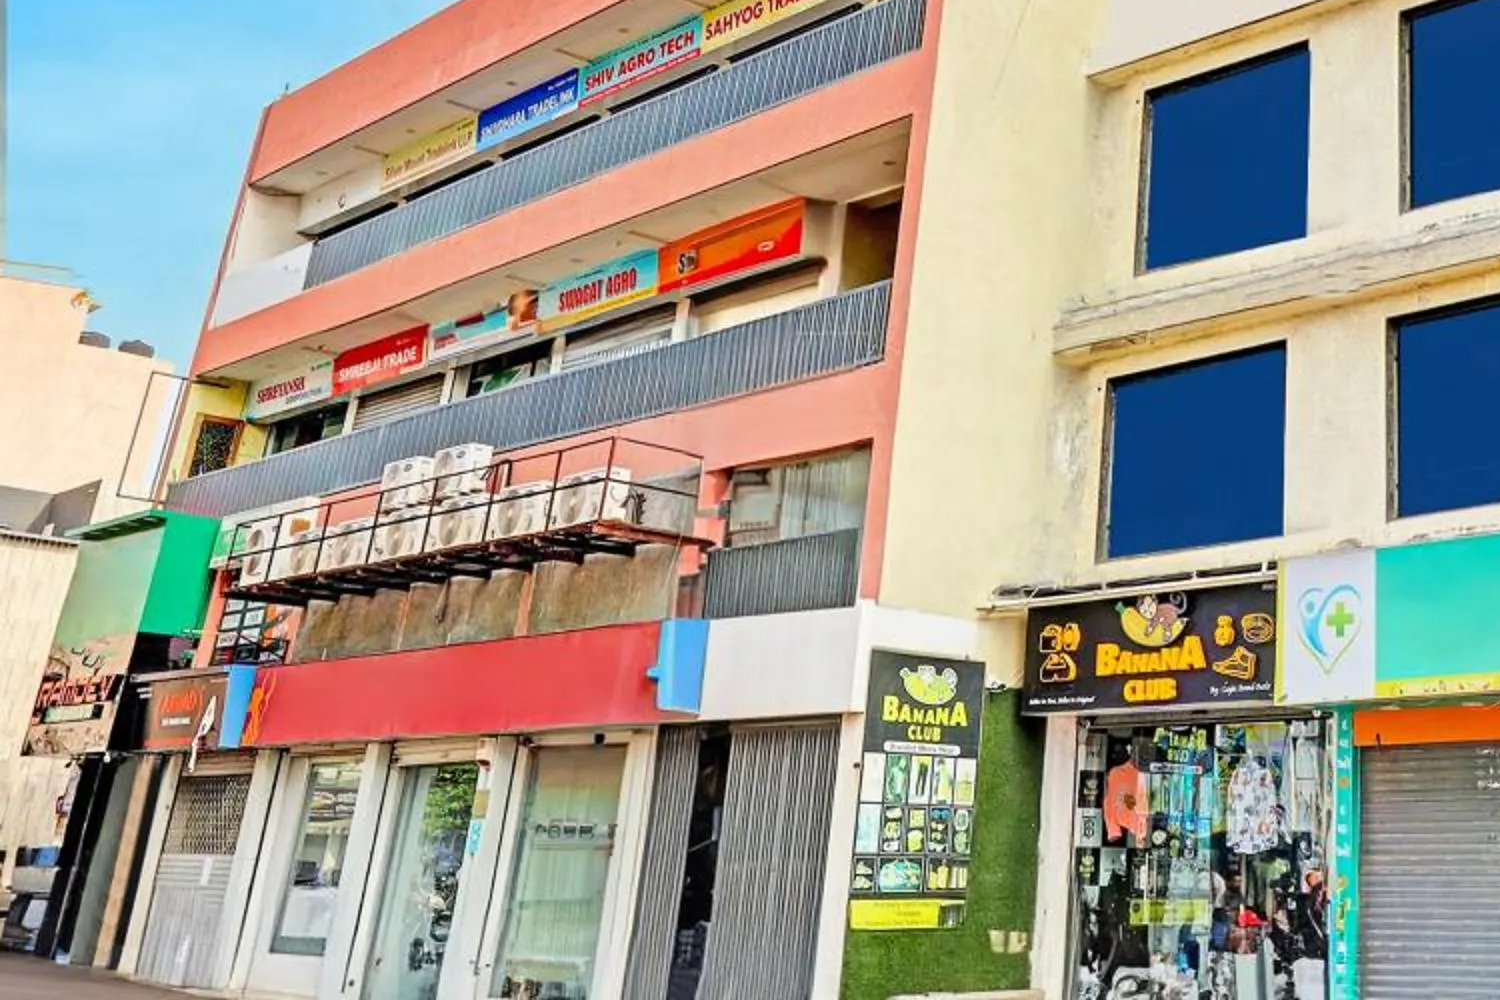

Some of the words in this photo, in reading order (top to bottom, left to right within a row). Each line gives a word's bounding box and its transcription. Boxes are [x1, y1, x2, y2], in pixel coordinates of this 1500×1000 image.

[705, 1, 764, 40] SAHYOG
[585, 66, 614, 92] SHIV
[618, 48, 655, 77] AGRO
[659, 29, 695, 58] TECH
[604, 267, 637, 297] AGRO
[383, 345, 418, 370] TRADE
[1095, 634, 1208, 677] BANANA
[1122, 677, 1178, 703] CLUB
[882, 695, 969, 727] BANANA
[907, 724, 942, 742] CLUB
